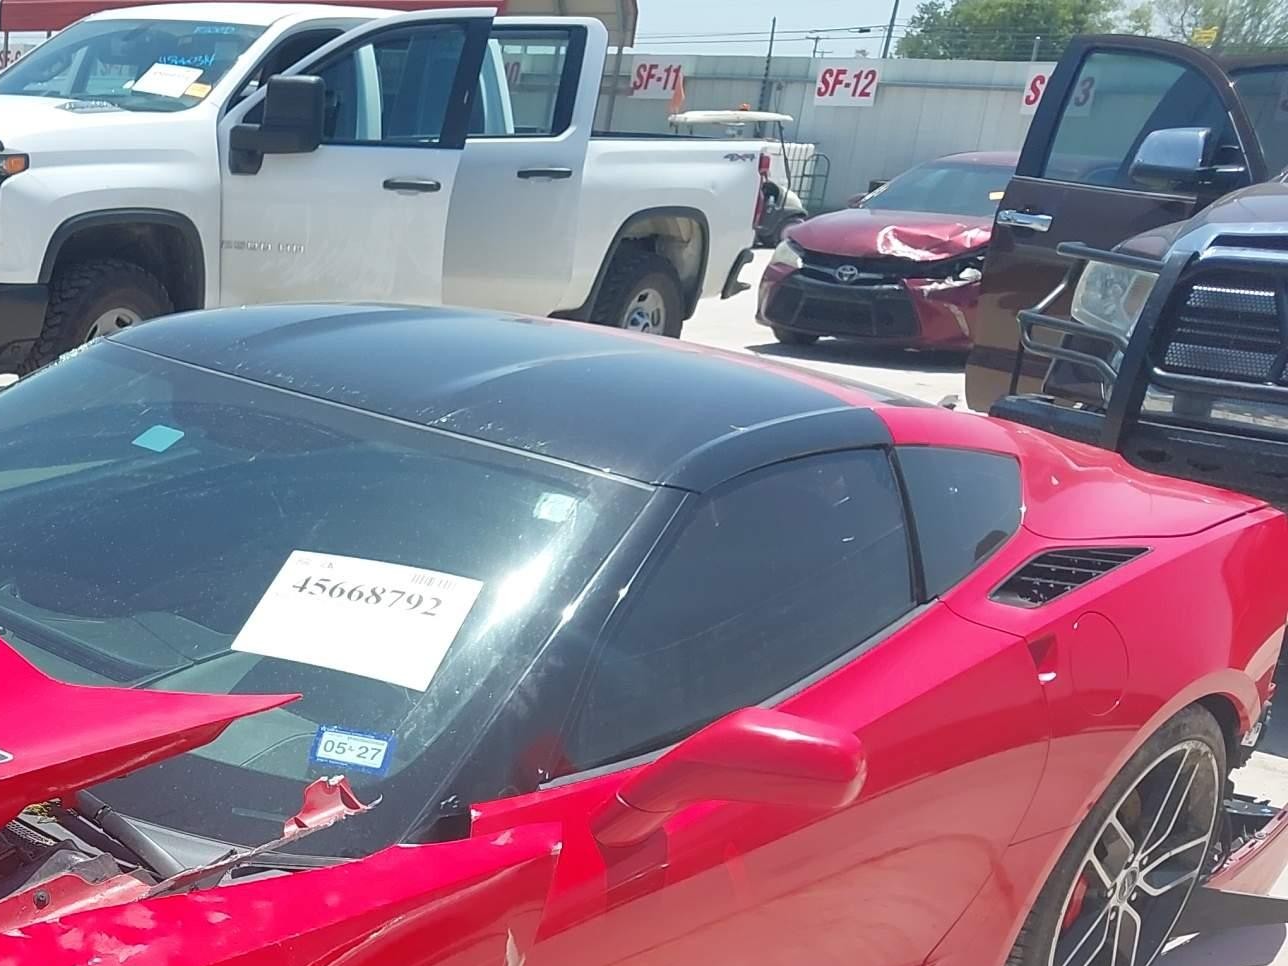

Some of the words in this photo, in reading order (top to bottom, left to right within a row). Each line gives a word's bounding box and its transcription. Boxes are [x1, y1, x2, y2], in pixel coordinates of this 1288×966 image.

[632, 63, 682, 90] SF-11
[817, 68, 877, 97] SF-12
[292, 575, 443, 617] 45668792
